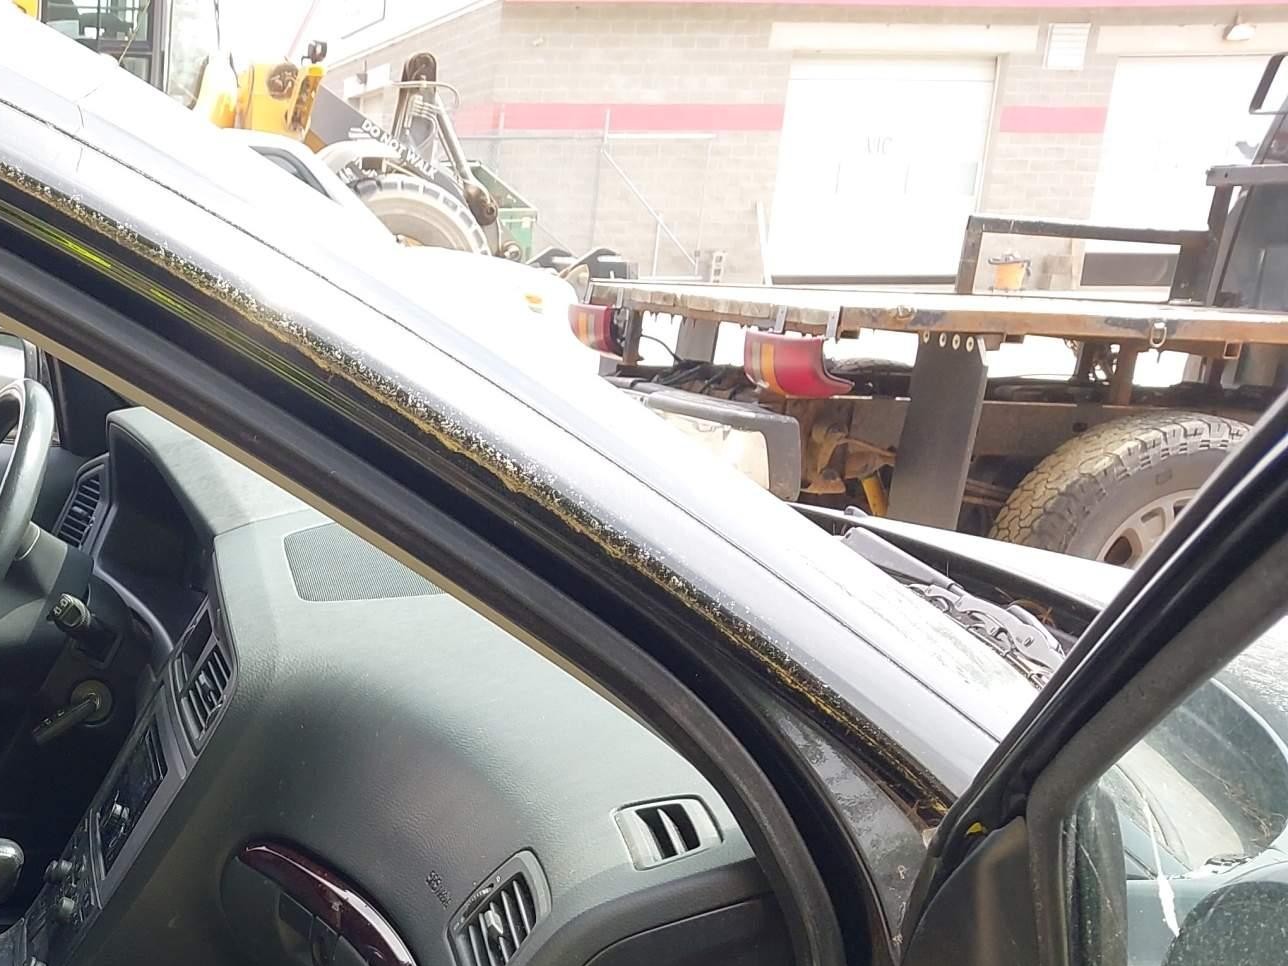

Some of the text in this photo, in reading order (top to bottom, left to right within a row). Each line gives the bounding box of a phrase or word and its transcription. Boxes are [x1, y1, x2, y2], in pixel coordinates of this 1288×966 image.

[361, 119, 439, 180] DO NOT WALK
